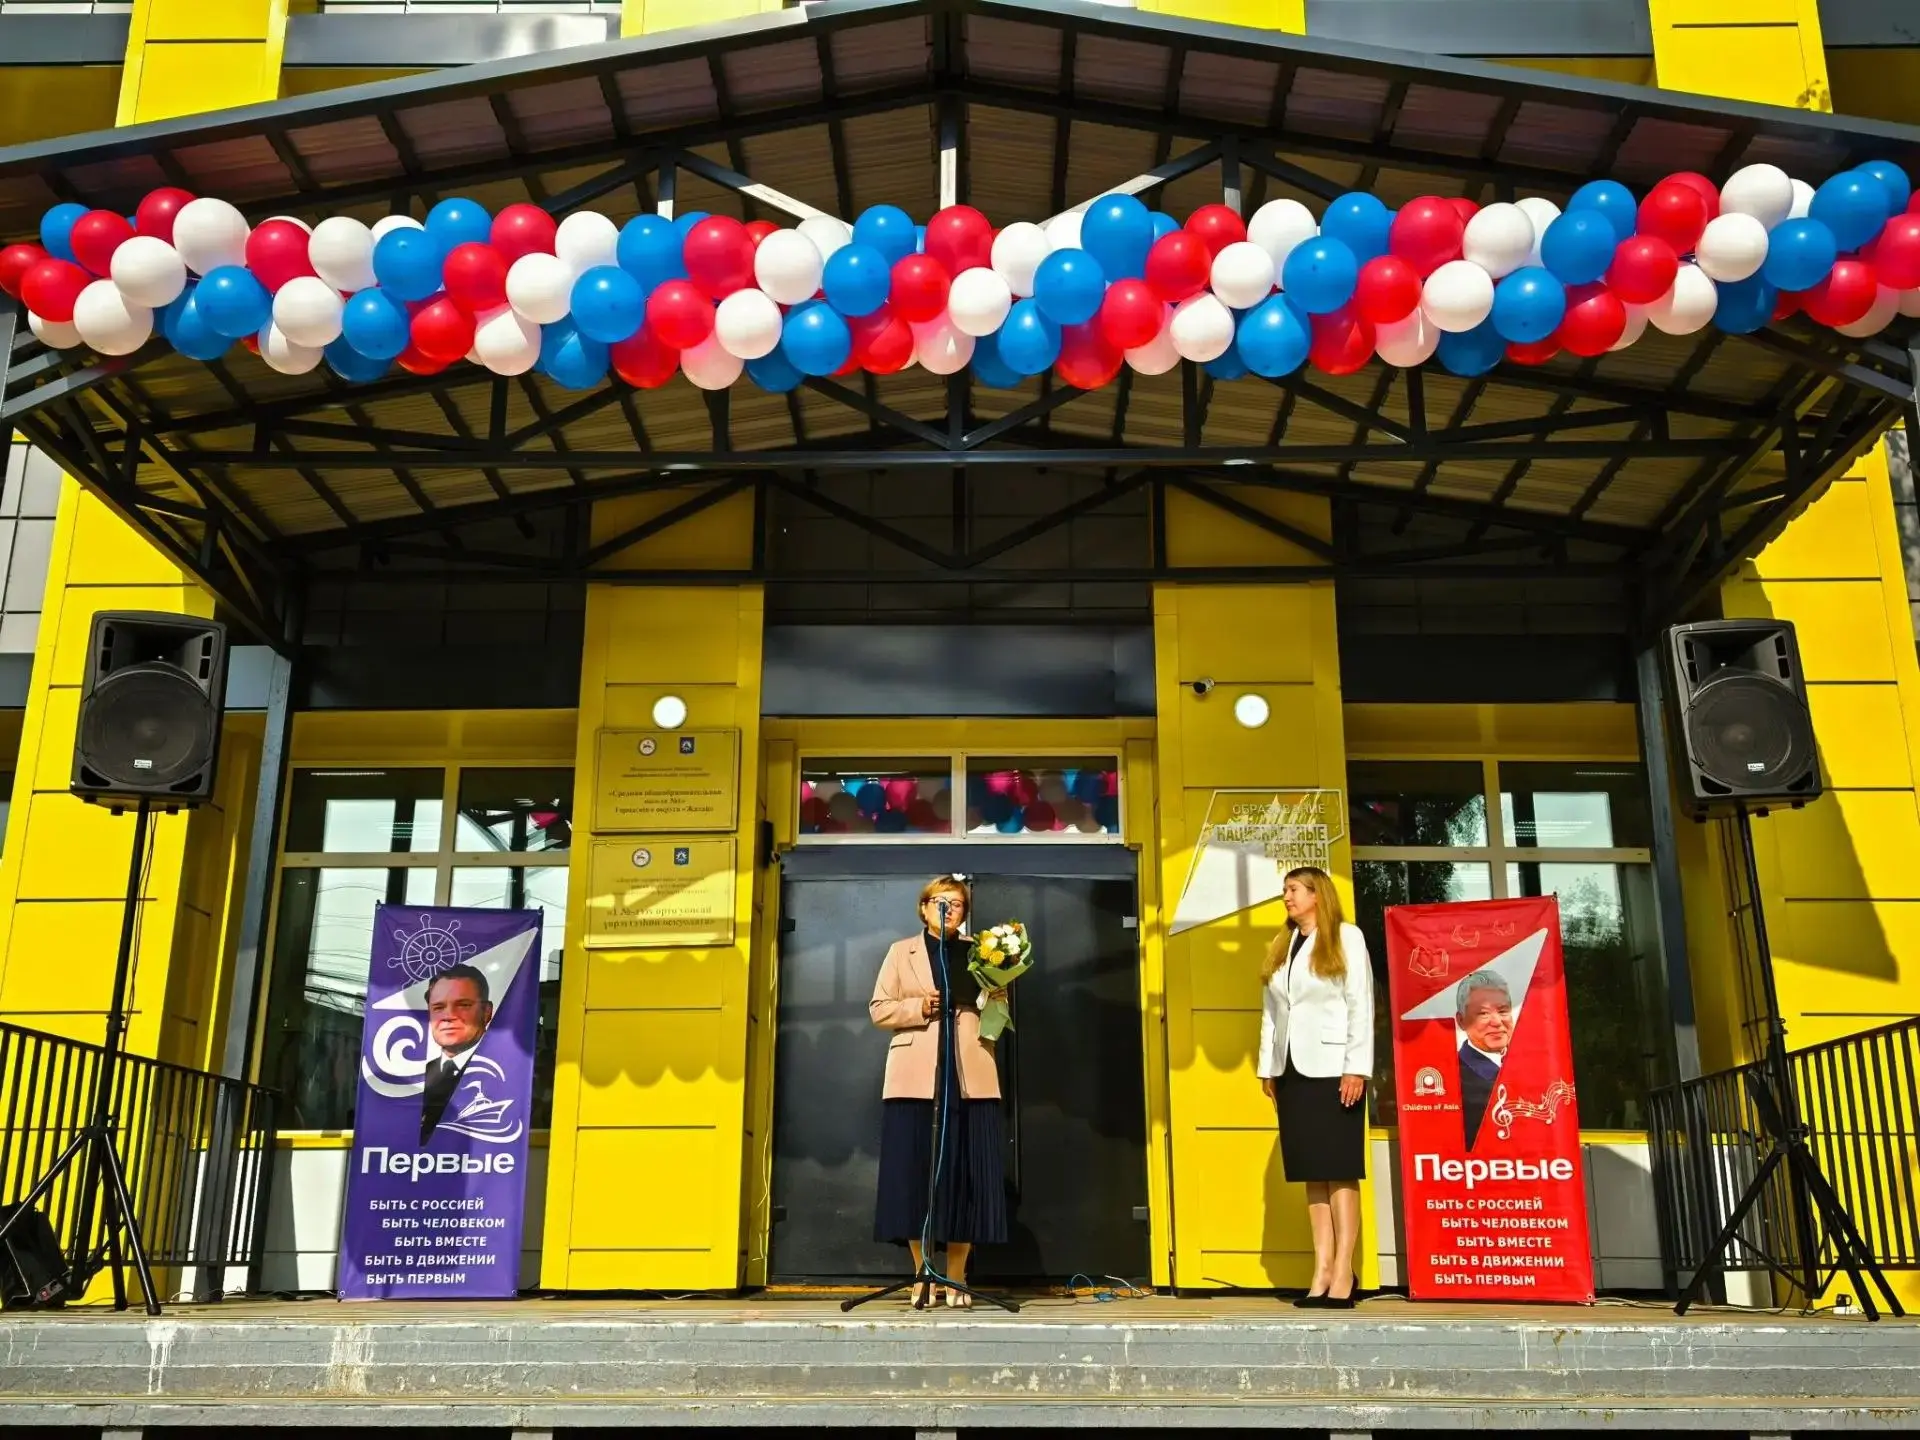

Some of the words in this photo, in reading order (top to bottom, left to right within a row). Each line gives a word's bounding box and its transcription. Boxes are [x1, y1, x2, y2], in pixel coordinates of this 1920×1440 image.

[1232, 803, 1326, 815] ОБРАЗВНИЕ
[1216, 826, 1325, 843] НАЦИОНАЛНЫЕ
[1263, 843, 1326, 858] ПРОЕКТЫ
[1402, 1103, 1432, 1111] Children
[361, 1147, 515, 1182] Первые
[1414, 1153, 1574, 1190] Первые
[369, 1199, 406, 1210] БЫТЬ
[410, 1199, 419, 1210] С
[421, 1197, 484, 1210] РОССИЕЙ
[1426, 1199, 1464, 1210] БЫТЬ
[1466, 1199, 1475, 1210] С
[1477, 1197, 1543, 1210] РОССИЕЙ
[382, 1218, 419, 1229] БЫТЬ
[422, 1218, 505, 1229] ЧЕЛОВЕКОМ
[1441, 1218, 1479, 1229] БЫТЬ
[1482, 1218, 1569, 1229] ЧЕЛОВЕКОМ
[394, 1236, 431, 1247] БЫТЬ
[435, 1236, 487, 1247] ВМЕСТЕ
[1457, 1236, 1494, 1247] БЫТЬ
[1497, 1236, 1552, 1247] ВМЕСТЕ
[364, 1255, 402, 1266] БЫТЬ
[405, 1255, 414, 1266] В
[416, 1255, 496, 1267] ДВИЖЕНИИ
[1430, 1255, 1467, 1266] БЫТЬ
[1471, 1255, 1479, 1266] В
[1482, 1255, 1564, 1267] ДВИЖЕНИИ
[366, 1273, 404, 1284] БЫТЬ
[407, 1273, 466, 1284] ПЕРВЫМ
[1435, 1274, 1472, 1285] БЫТЬ
[1475, 1274, 1535, 1285] ПЕРВЫМ
